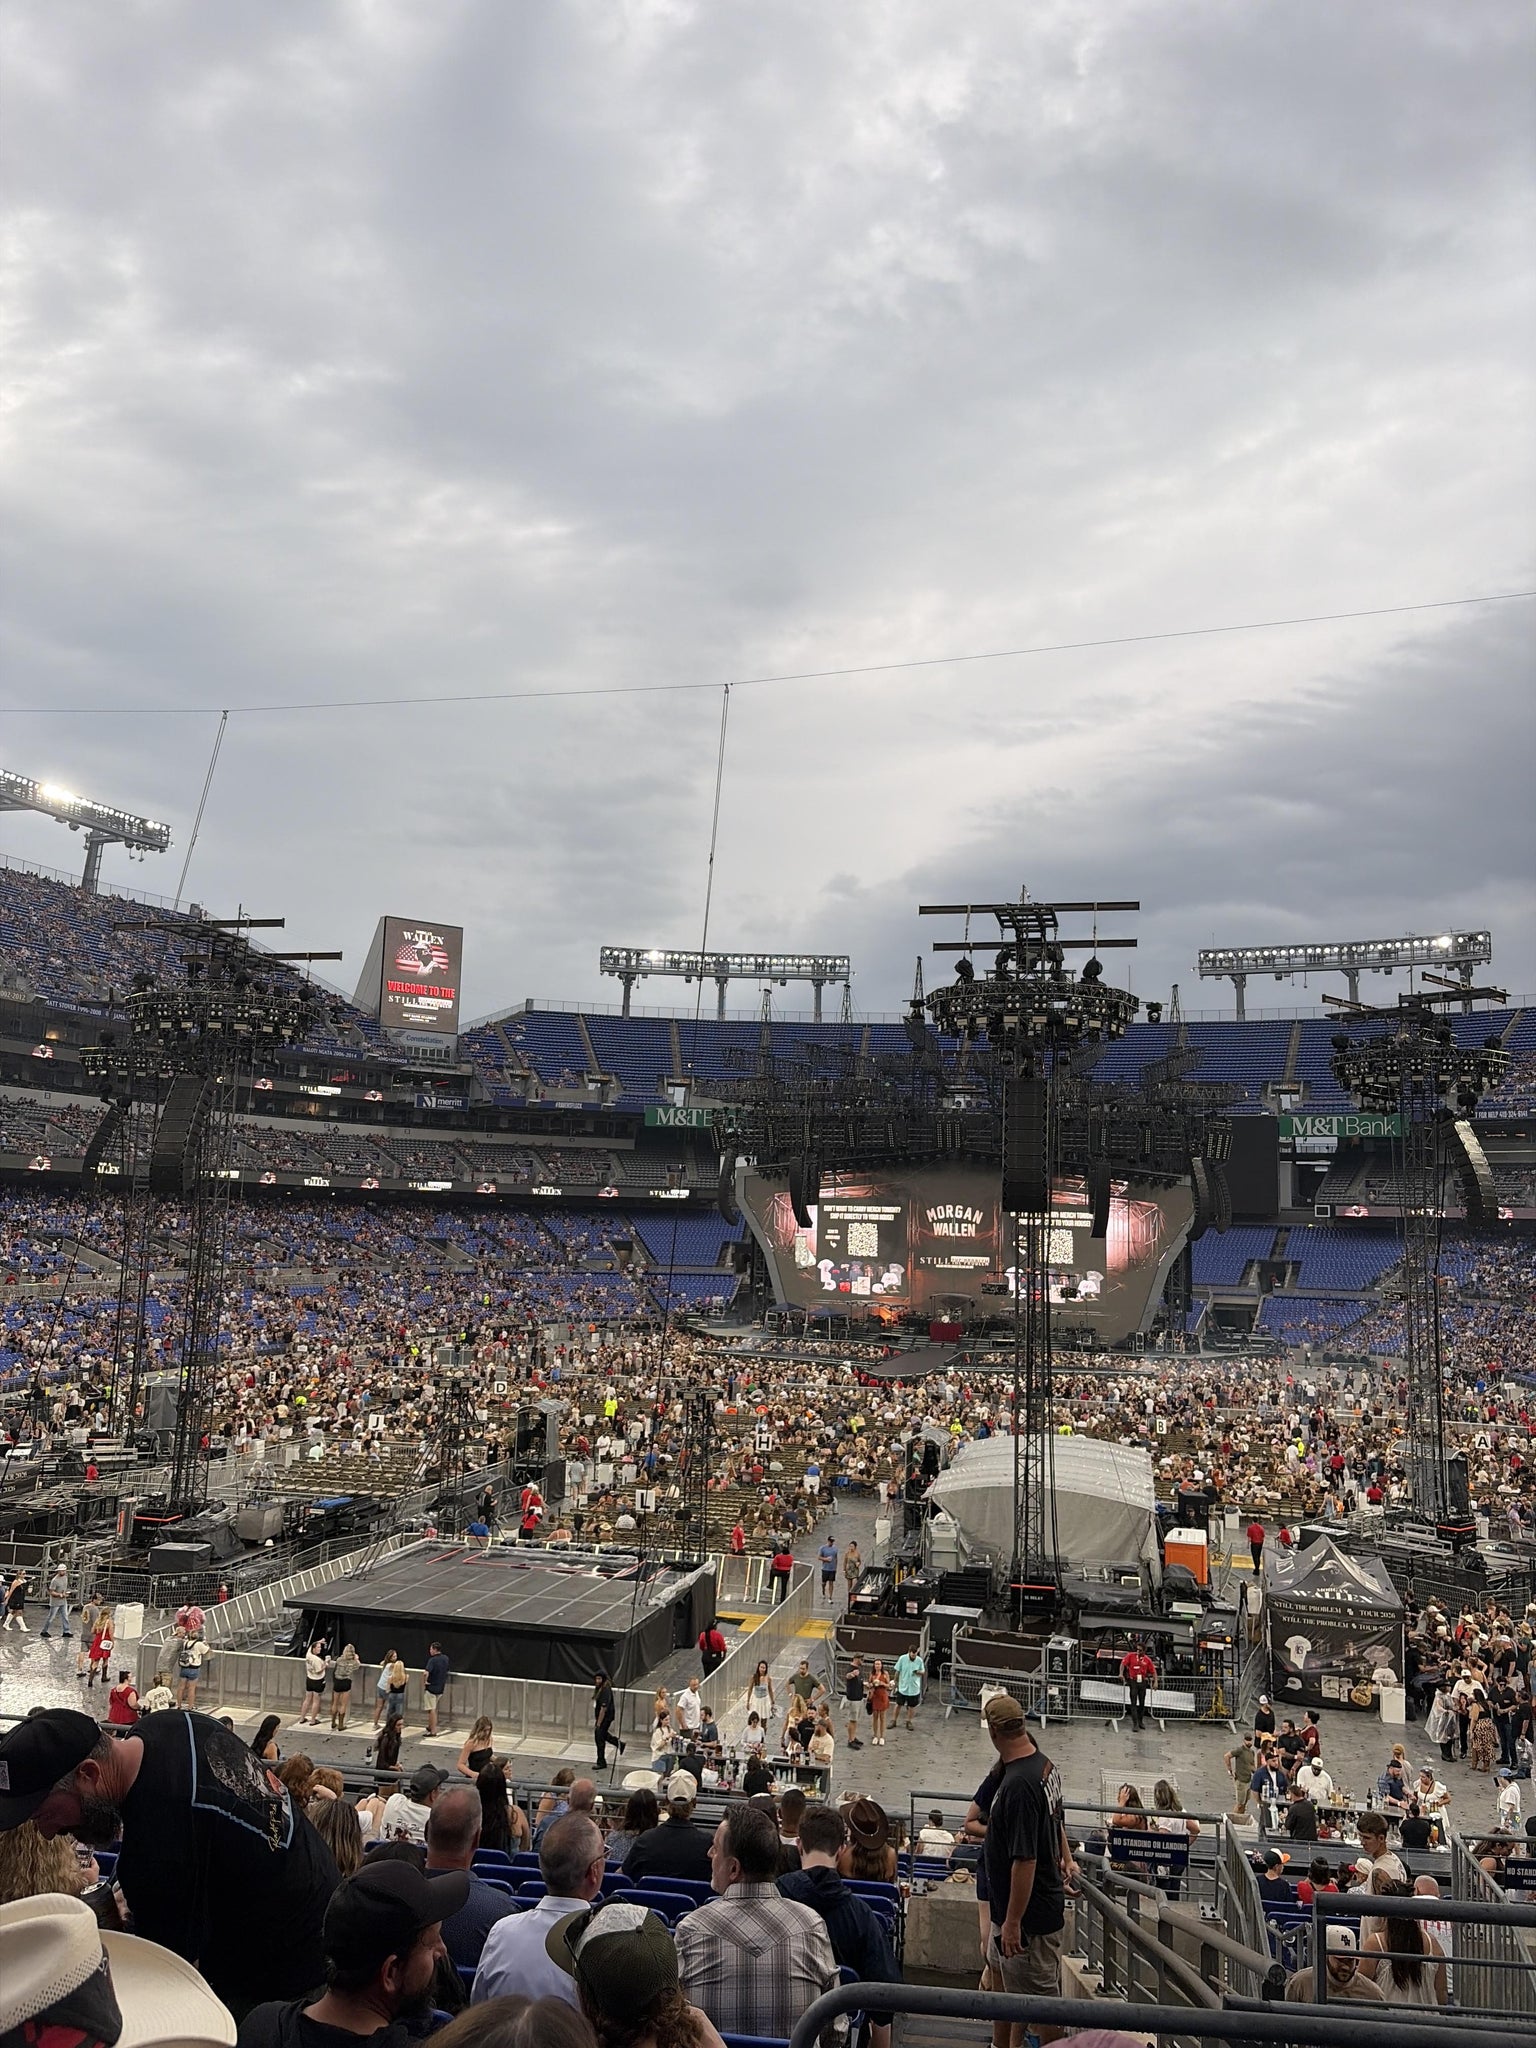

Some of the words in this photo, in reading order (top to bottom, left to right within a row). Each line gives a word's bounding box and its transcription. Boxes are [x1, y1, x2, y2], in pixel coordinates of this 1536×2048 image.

[387, 980, 428, 996] WELCOME
[428, 985, 440, 997] TO
[440, 987, 456, 999] THE
[388, 995, 419, 1005] STILL
[406, 1034, 444, 1044] Constellation
[437, 1098, 463, 1106] merritt
[656, 1108, 702, 1126] M&T
[1292, 1116, 1344, 1136] M&T
[1346, 1117, 1397, 1136] Bank
[926, 1204, 984, 1225] MORGAN
[933, 1222, 976, 1238] WALLEN
[920, 1256, 950, 1265] STILL
[496, 1383, 506, 1392] D
[372, 1416, 380, 1428] J
[1158, 1421, 1164, 1432] B
[758, 1436, 770, 1448] H
[1478, 1436, 1489, 1448] A
[640, 1492, 650, 1508] L
[1292, 1590, 1373, 1604] WALLEN
[1274, 1601, 1294, 1610] STILL
[1309, 1605, 1342, 1614] PROBLEM
[1360, 1610, 1380, 1618] TOUR
[1282, 1615, 1302, 1624] STILL
[1316, 1620, 1349, 1628] PROBLEM
[1360, 1623, 1378, 1632] TOUR
[1113, 1837, 1122, 1846] NO
[1123, 1838, 1152, 1849] STANDING
[1152, 1840, 1161, 1849] ON
[1162, 1842, 1188, 1851] LANDING
[1506, 1867, 1516, 1876] NO
